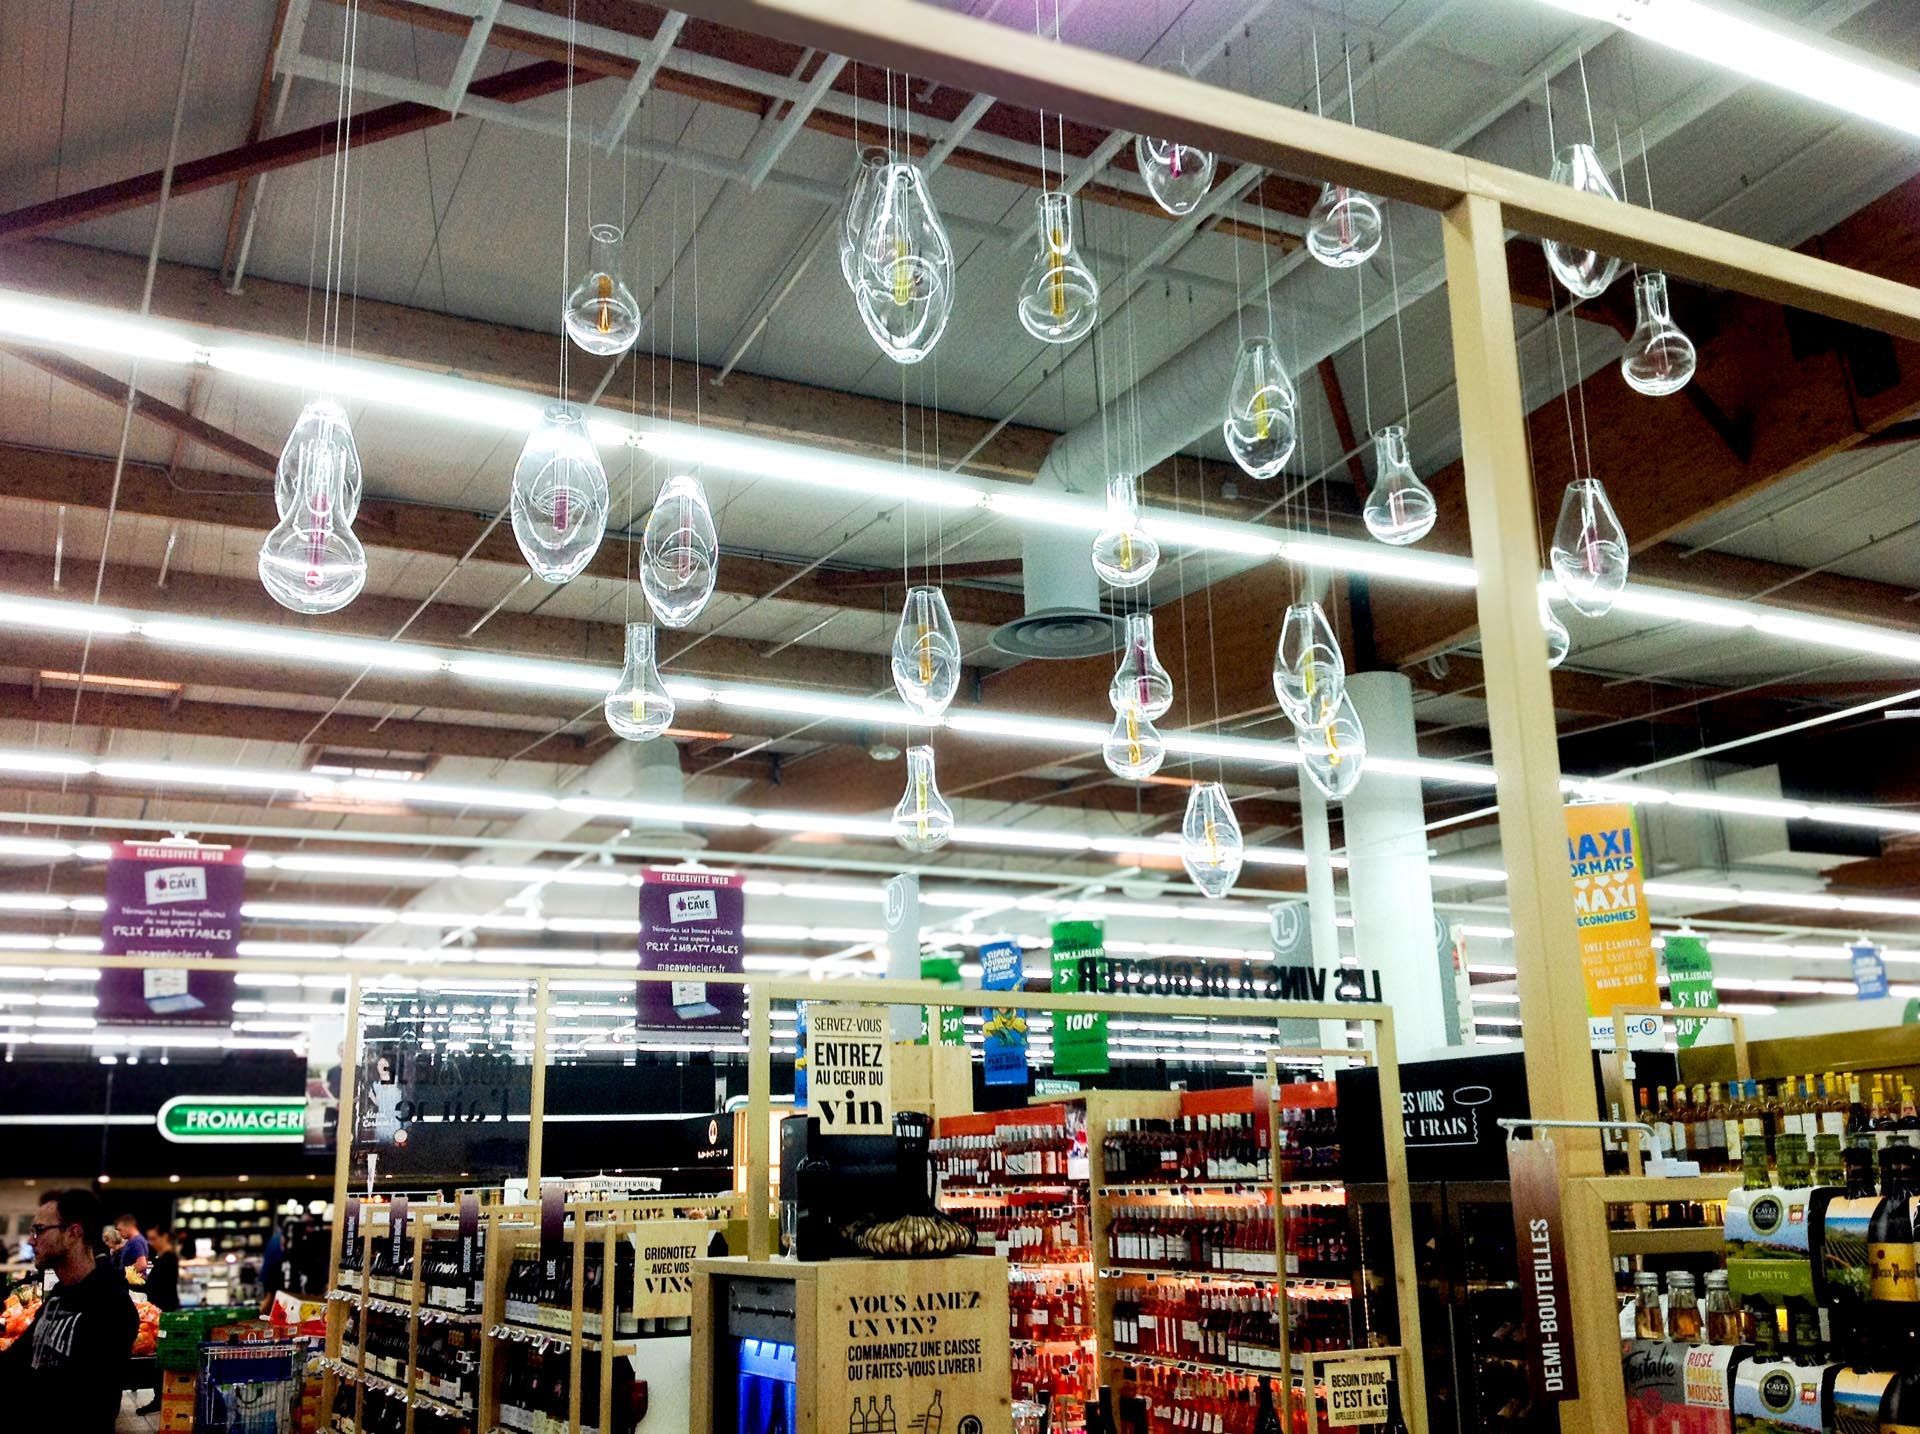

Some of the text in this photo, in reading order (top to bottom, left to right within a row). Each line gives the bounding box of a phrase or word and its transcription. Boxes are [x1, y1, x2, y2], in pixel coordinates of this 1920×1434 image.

[1568, 828, 1632, 861] AXI
[201, 850, 225, 861] WEB
[169, 878, 197, 889] CAVE
[711, 875, 729, 885] WEB
[687, 899, 711, 910] CAVE
[112, 925, 232, 940] PRIX IMBATTABLES
[646, 941, 740, 955] PRIX IMBATTABLES
[657, 963, 726, 974] macaveleclerc.fr
[815, 1017, 882, 1033] SERVEZ-VOUS
[815, 1042, 883, 1068] ENTREZ
[815, 1069, 884, 1087] AU CŒUR DU
[818, 1089, 884, 1126] vin
[1416, 1089, 1445, 1113] VINS
[1403, 1117, 1467, 1138] U FRAIS
[644, 1245, 697, 1260] GRIGNOTEZ
[546, 1258, 556, 1280] LOIRE
[651, 1262, 690, 1275] AVEC VOS
[645, 1277, 693, 1294] VINS
[849, 1291, 982, 1314] VOUS AIMEZ
[1529, 1218, 1564, 1392] DEMI-BOUTEILLES
[849, 1318, 879, 1338] UN
[848, 1338, 981, 1362] COMMANDEZ UNE CAISSE
[1687, 1351, 1714, 1368] ROSÉ
[848, 1365, 863, 1381] OU
[866, 1360, 935, 1380] FAITES-VOUS
[938, 1358, 975, 1375] LIVRER
[1331, 1371, 1386, 1388] BESOIN D'AIDE
[1333, 1388, 1388, 1409] C'EST ici
[1687, 1384, 1724, 1403] MOUSSE
